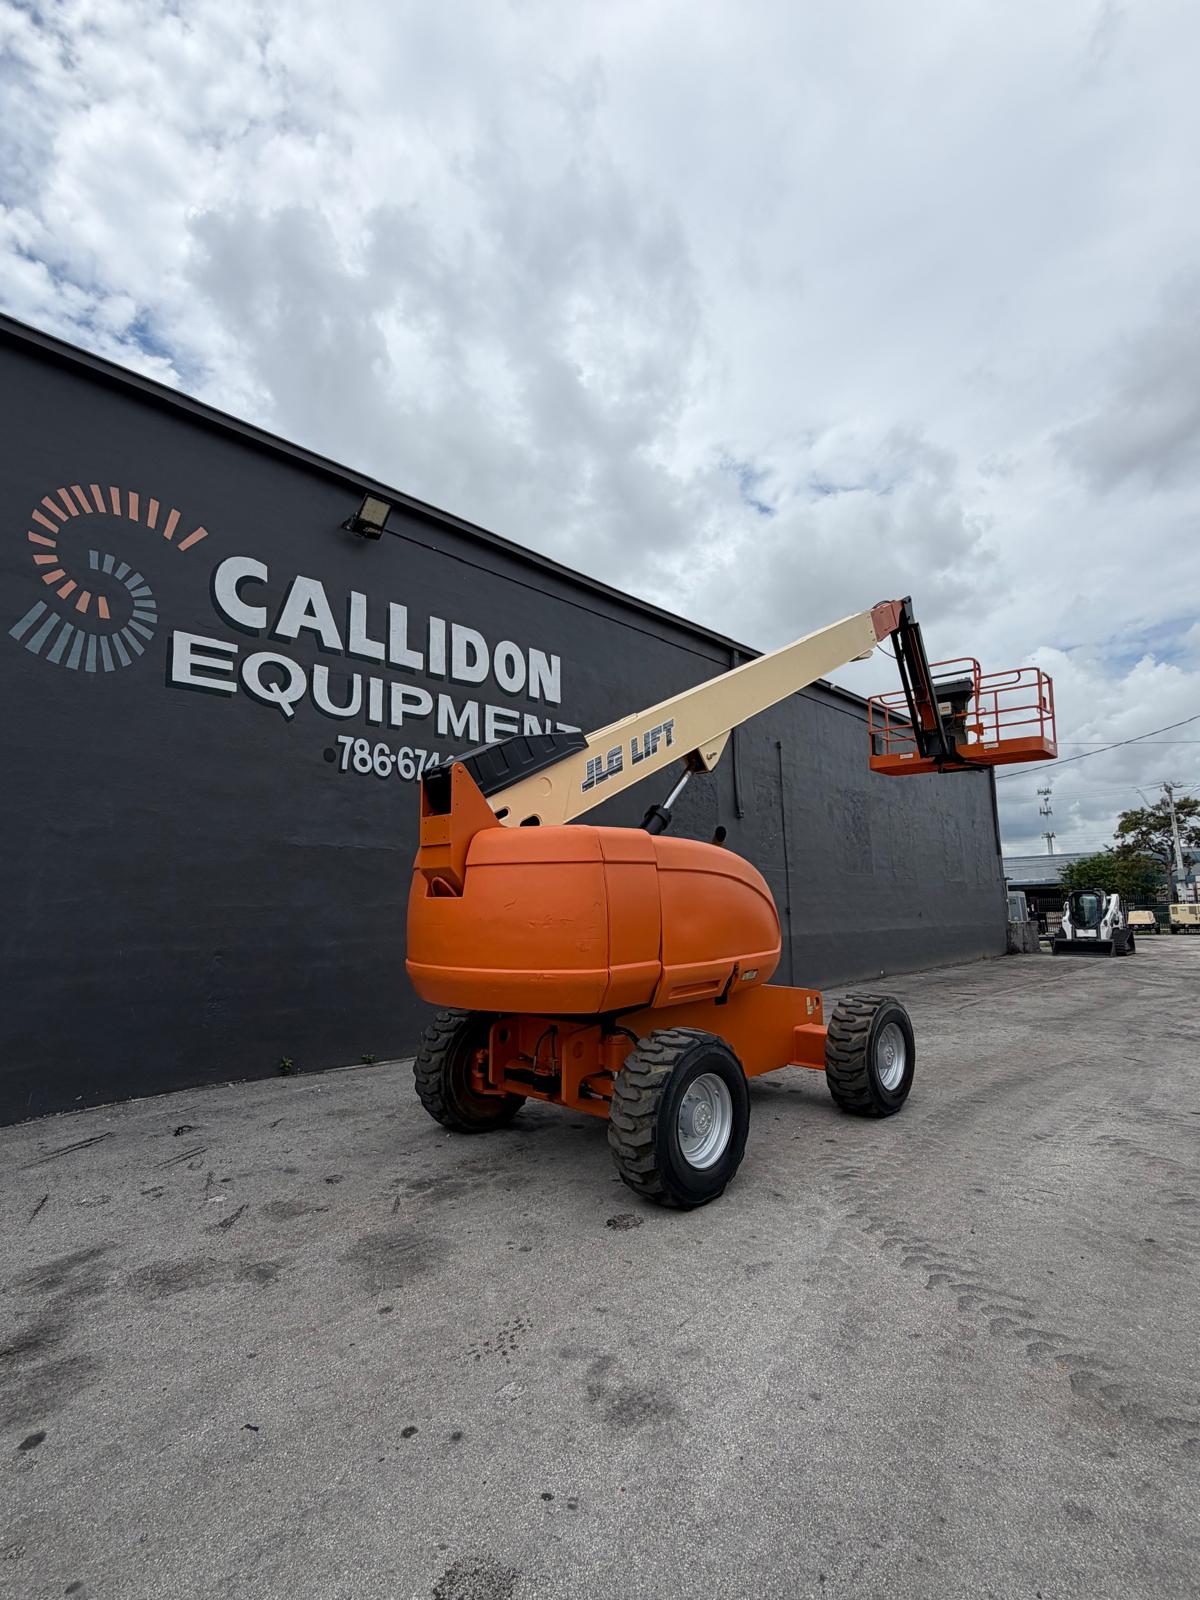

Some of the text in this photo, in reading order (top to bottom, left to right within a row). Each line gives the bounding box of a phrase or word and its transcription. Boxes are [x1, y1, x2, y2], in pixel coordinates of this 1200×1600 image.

[215, 556, 561, 703] CALLIDON
[581, 718, 675, 793] JLG LIFT
